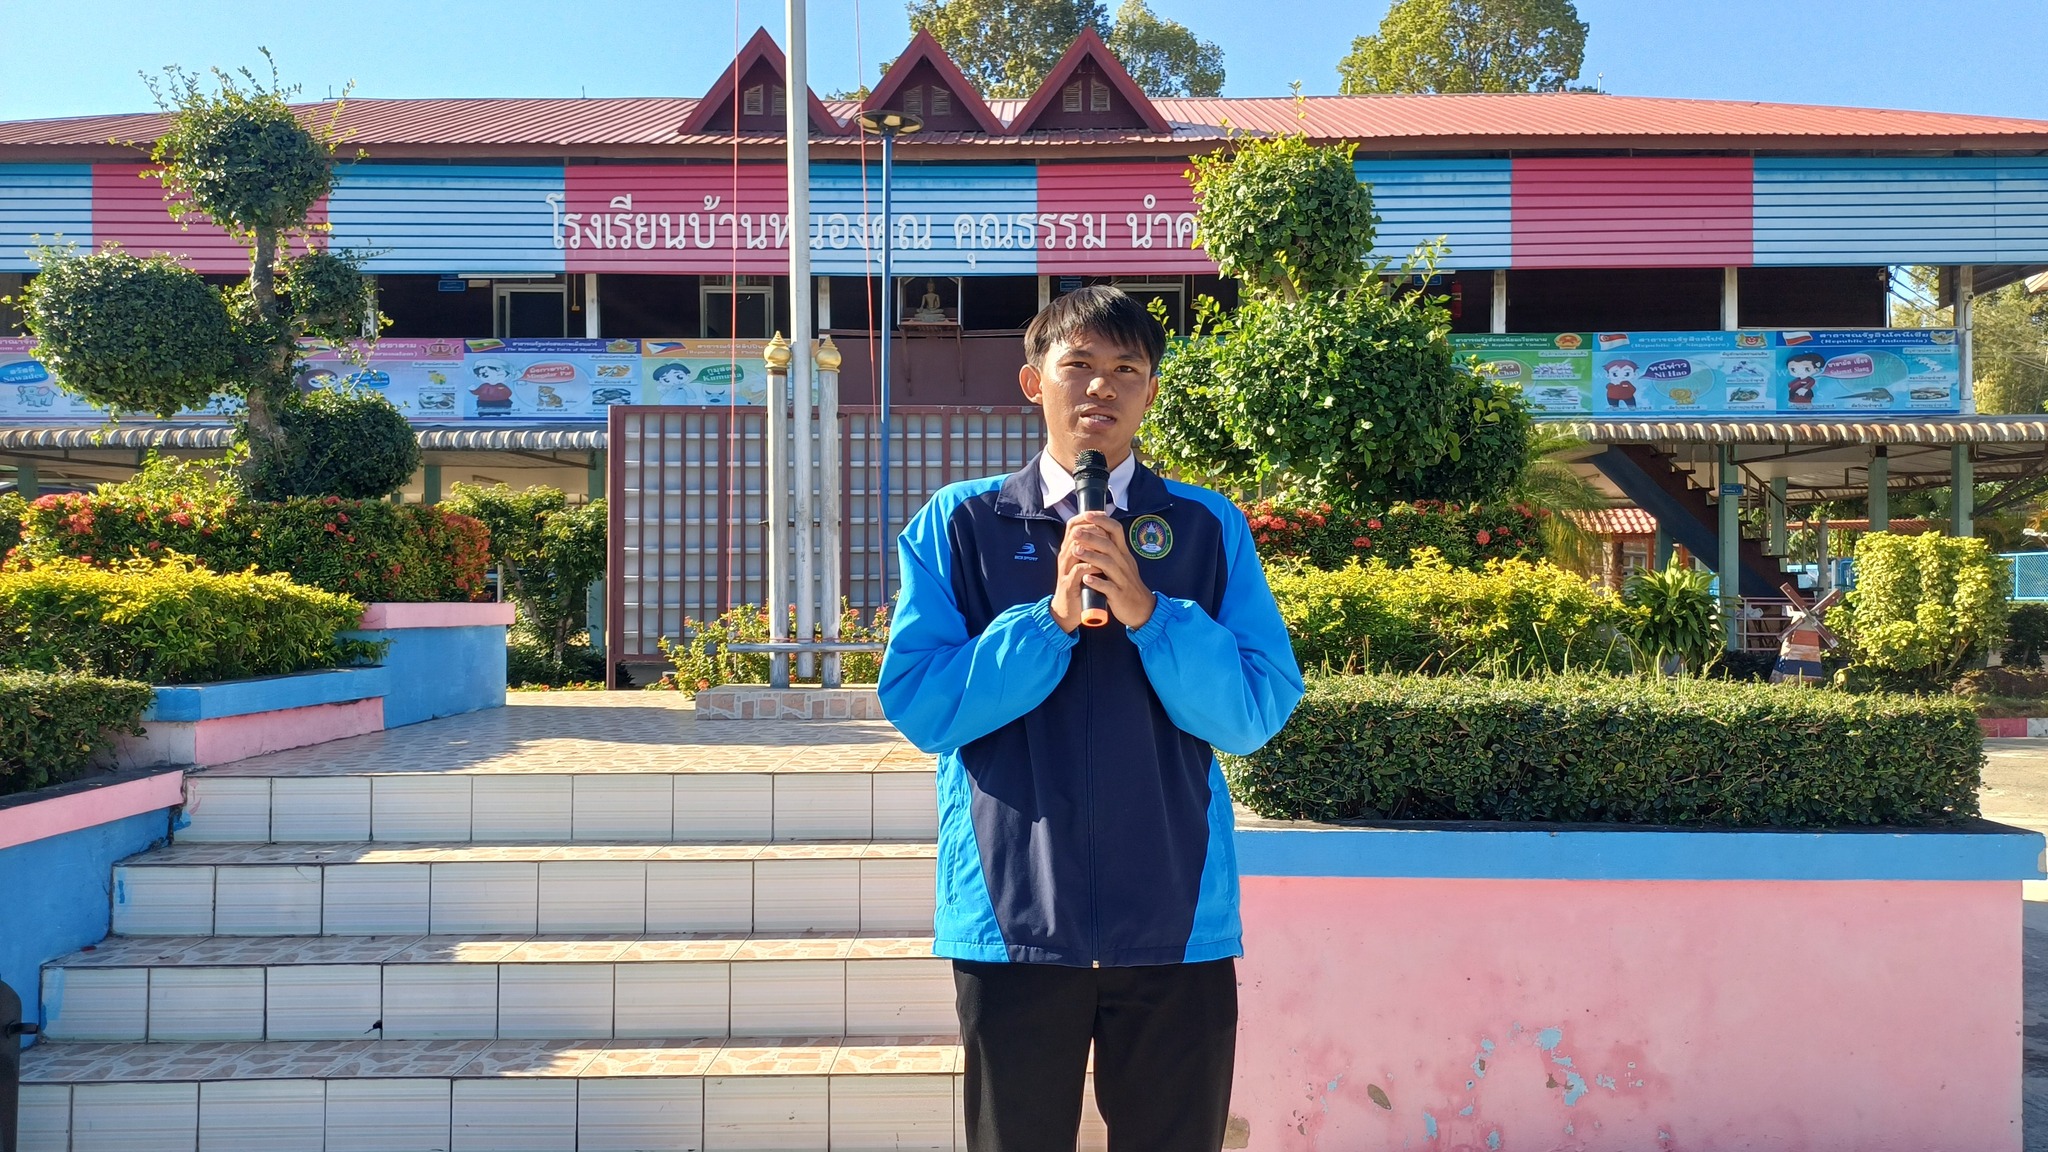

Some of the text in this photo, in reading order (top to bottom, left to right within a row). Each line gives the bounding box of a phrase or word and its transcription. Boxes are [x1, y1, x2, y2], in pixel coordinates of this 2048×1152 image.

[954, 212, 1107, 269] คุณธรรม
[1654, 370, 1666, 378] Ni
